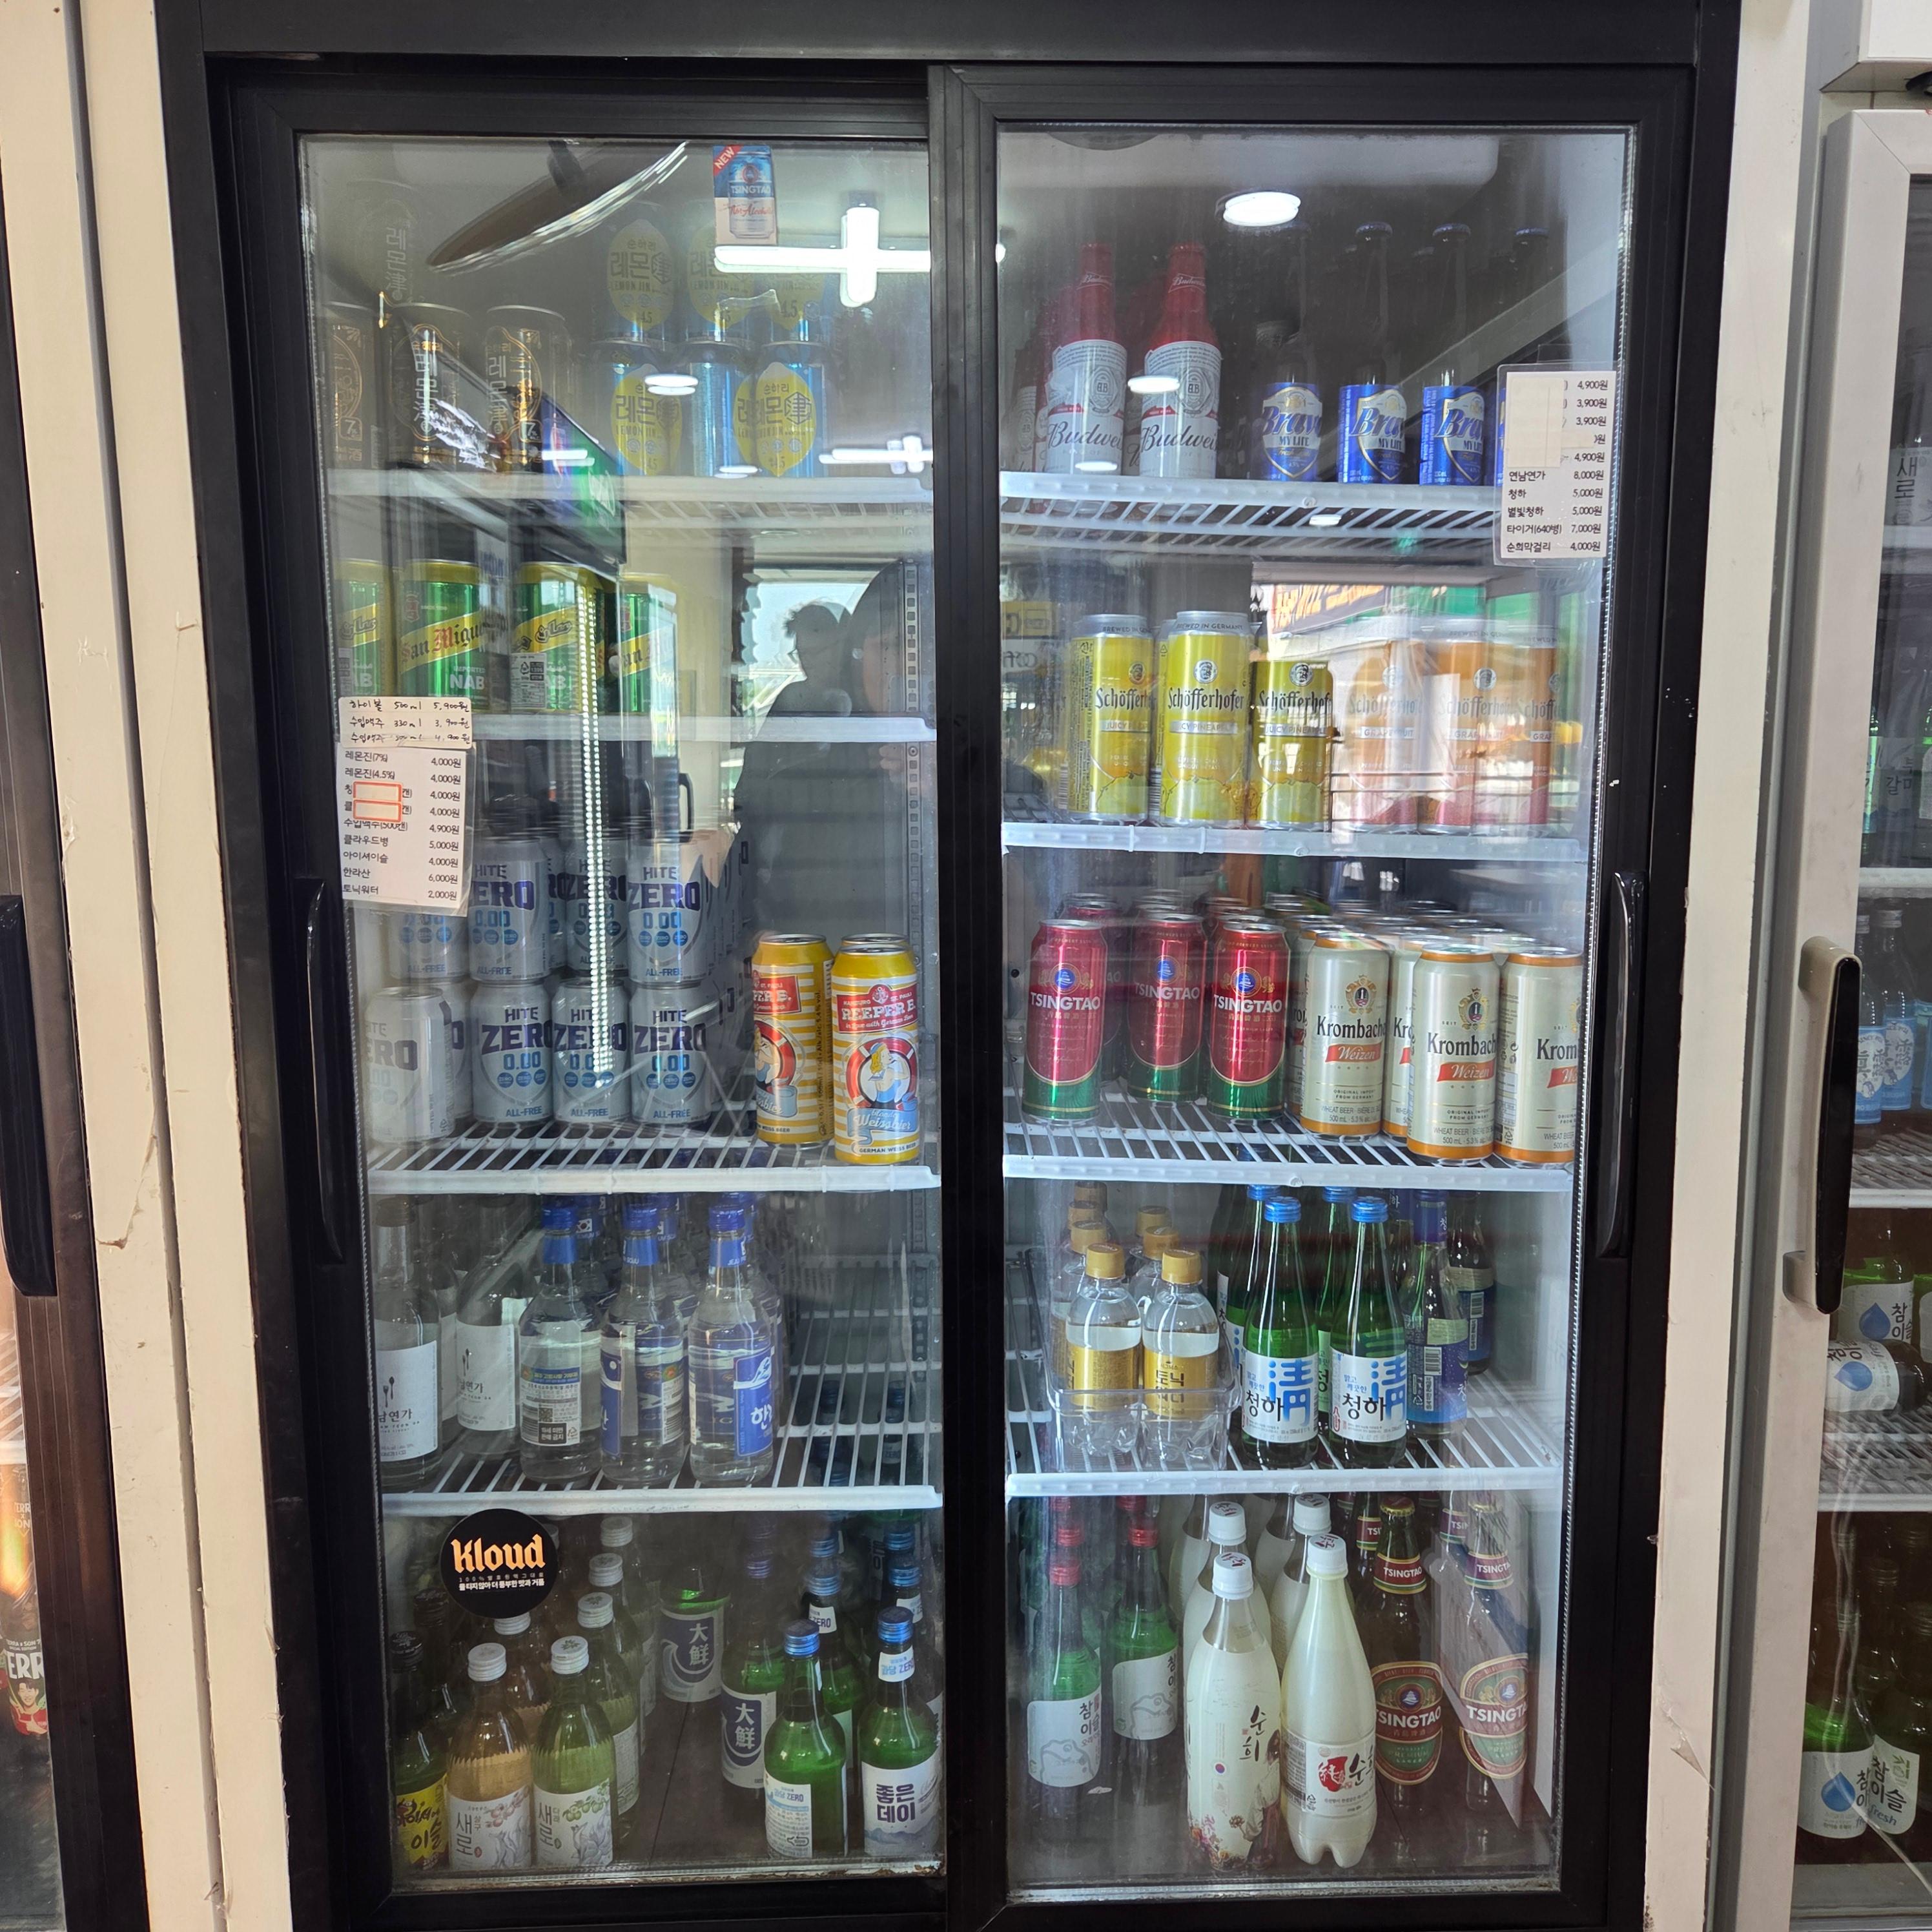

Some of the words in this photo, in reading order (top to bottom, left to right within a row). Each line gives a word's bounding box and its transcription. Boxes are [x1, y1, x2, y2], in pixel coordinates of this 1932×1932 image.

[714, 147, 735, 169] NEW
[730, 185, 771, 194] TSINGTAO
[1577, 380, 1608, 390] 4,900원
[1577, 398, 1607, 408] 3,900원
[1576, 416, 1607, 426] 3,900원
[1279, 437, 1292, 446] MY
[1293, 437, 1310, 446] LIFE
[1574, 452, 1605, 462] 4,900원
[1509, 471, 1546, 482] 연남연가
[1574, 470, 1604, 480] 8,000원
[1508, 489, 1526, 500] 청하
[1572, 488, 1603, 498] 5,000원
[1508, 506, 1544, 517] 별빛청하
[1572, 506, 1602, 516] 5,000원
[1571, 524, 1601, 534] 7,000원
[1506, 542, 1551, 553] 순희막걸리
[1570, 541, 1601, 551] 4,000원
[401, 639, 429, 662] San
[449, 673, 485, 690] NAB
[349, 699, 382, 712] 하이볼
[433, 701, 469, 712] 5,900원
[1168, 685, 1245, 710] Schöfferhofer
[1266, 725, 1286, 734] JUICY
[431, 757, 462, 768] 4,000원
[430, 774, 461, 785] 4,000원
[430, 791, 460, 801] 4,000원
[429, 808, 460, 818] 4,000원
[429, 824, 460, 834] 4,900원
[344, 834, 389, 847] 클라우드병
[429, 841, 458, 851] 5,000원
[343, 851, 389, 864] 아이셔이슬
[429, 858, 458, 868] 4,000원
[343, 867, 371, 878] 한라산
[428, 874, 458, 884] 6,000원
[475, 865, 507, 879] HITE
[643, 867, 677, 880] HITE
[343, 885, 379, 895] 토닉워터
[428, 890, 457, 901] 2,000원
[472, 881, 535, 910] ERO
[628, 881, 701, 911] ZERO
[475, 910, 511, 927] 0.00
[643, 912, 682, 929] 0.00
[646, 968, 683, 976] ALL-FREE
[1135, 982, 1200, 1000] TSINGTAO
[1031, 992, 1101, 1011] TSINGTAO
[1214, 994, 1282, 1013] TSINGTAO
[505, 1007, 539, 1023] HITE
[653, 1009, 687, 1024] HITE
[841, 1002, 905, 1020] REEPER
[481, 1019, 552, 1055] ZERO
[634, 1023, 706, 1054] ZERO
[504, 1051, 541, 1071] 0.00
[1338, 1046, 1375, 1060] Weizen
[652, 1054, 690, 1072] 0.00
[1452, 1064, 1489, 1078] Weizen
[506, 1106, 542, 1117] ALL-FREE
[571, 1108, 609, 1117] ALL-FREE
[653, 1109, 690, 1118] ALL-FREE
[854, 1115, 911, 1129] Weissbier
[1246, 1390, 1284, 1421] 청하
[1342, 1393, 1386, 1421] 청하
[451, 1534, 546, 1574] Kloud
[1384, 1567, 1422, 1578] TSINGTAO
[688, 1623, 710, 1667] 大鮮
[1377, 1705, 1441, 1729] SINGTAO
[735, 1703, 755, 1750] 大鮮
[1240, 1705, 1266, 1762] 순희
[786, 1793, 803, 1802] ZERO
[876, 1783, 915, 1804] 좋은
[878, 1802, 916, 1823] 데이
[539, 1802, 553, 1846] 새로
[456, 1812, 473, 1856] 새로
